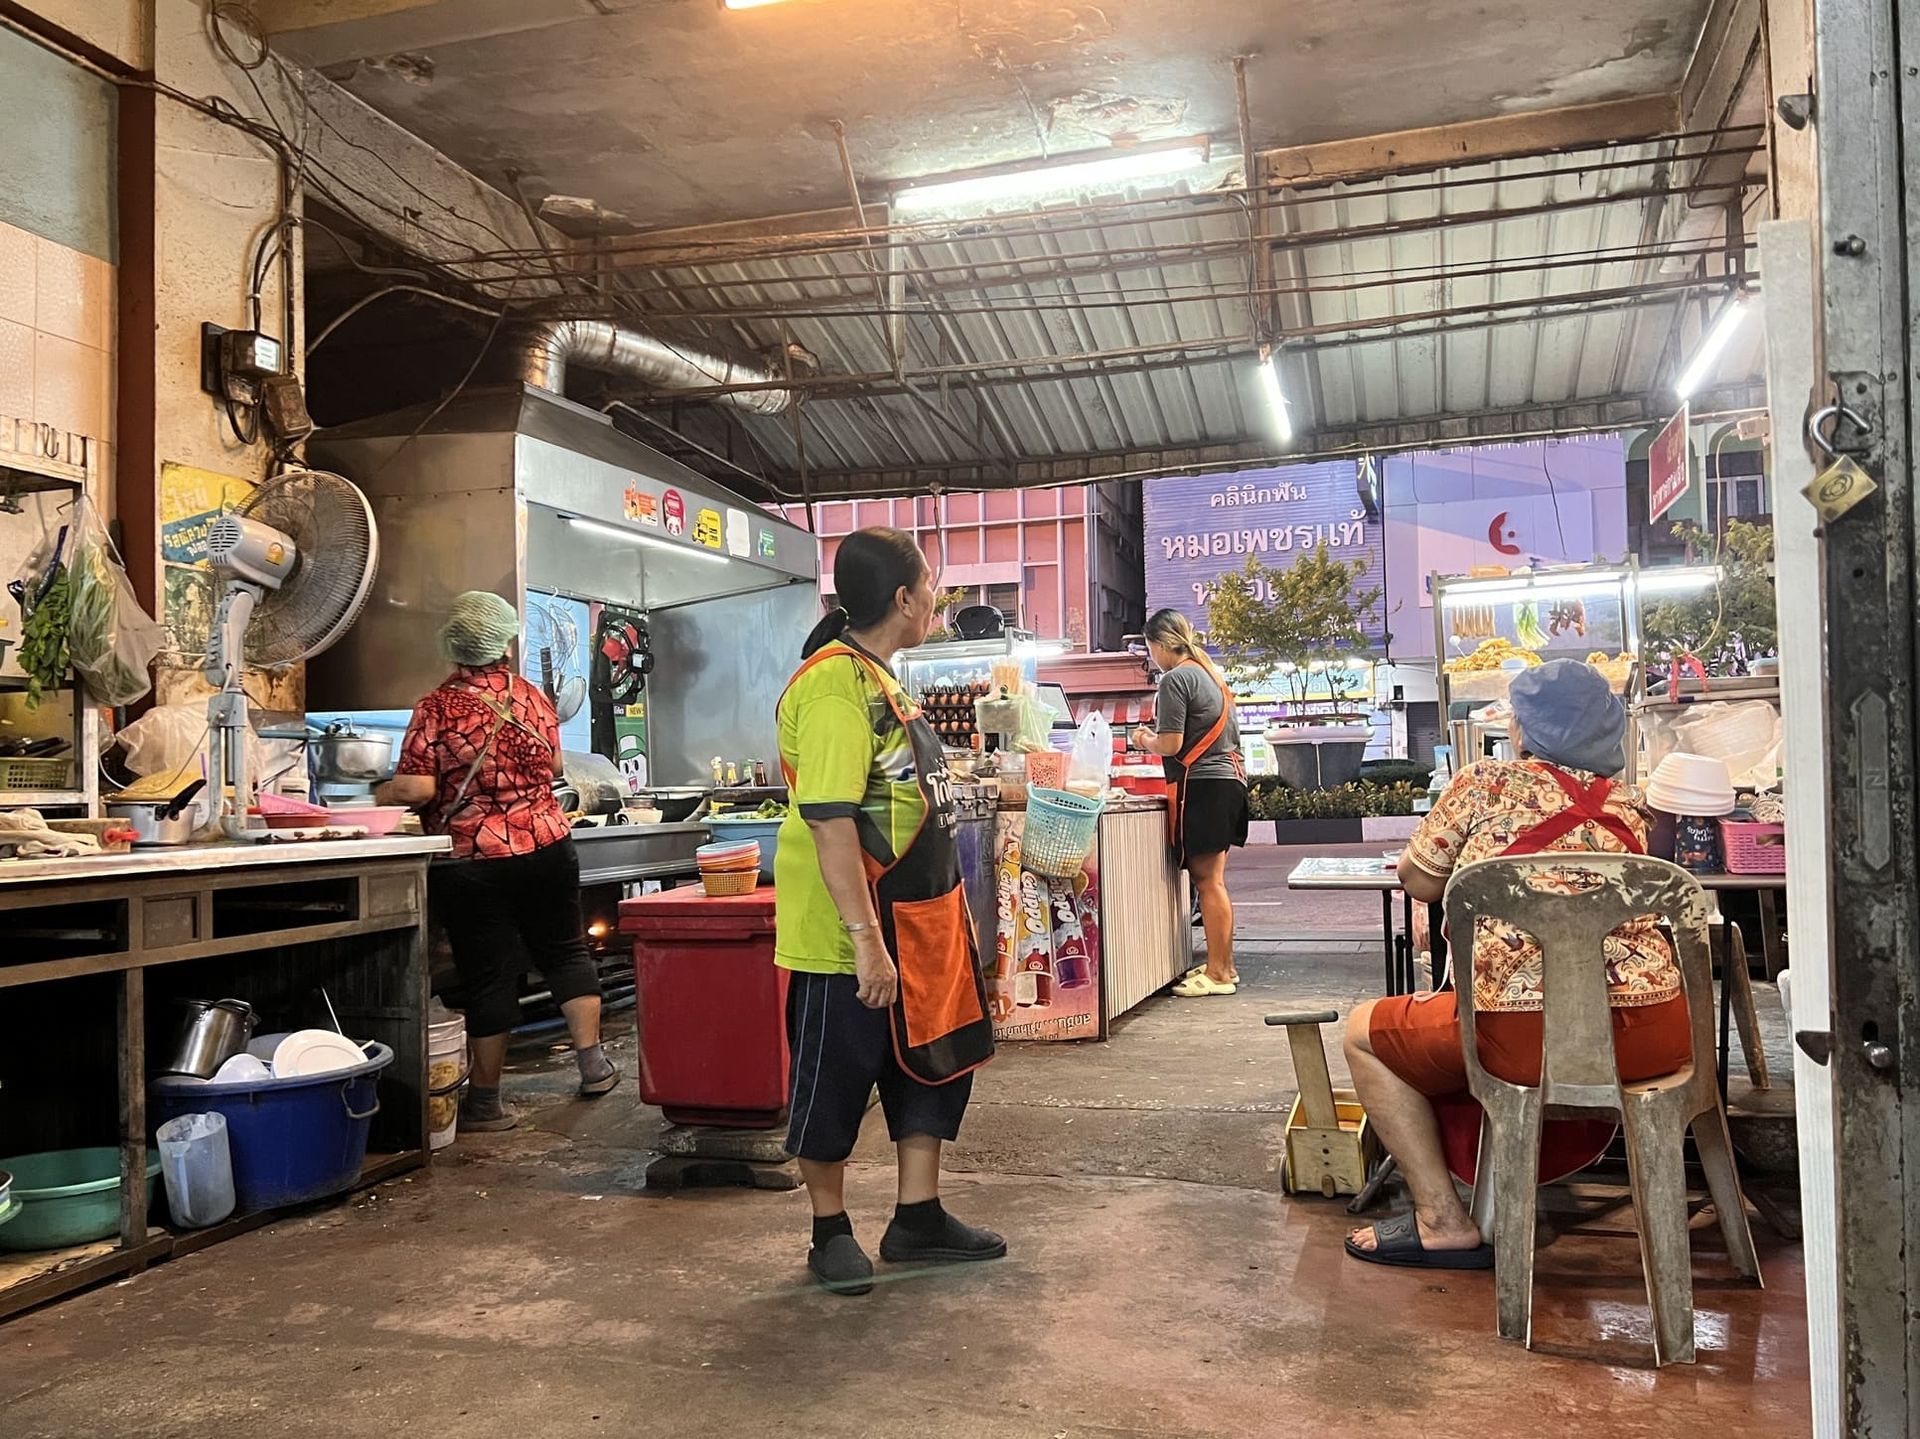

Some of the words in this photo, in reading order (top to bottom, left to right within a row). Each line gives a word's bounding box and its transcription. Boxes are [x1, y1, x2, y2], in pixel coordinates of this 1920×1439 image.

[1210, 481, 1308, 508] คลินิกฟัน
[1160, 509, 1367, 559] หมอเพชรแท้
[997, 868, 1013, 921] Calippo
[1020, 870, 1046, 934] Calippo
[1050, 877, 1076, 922] alippo
